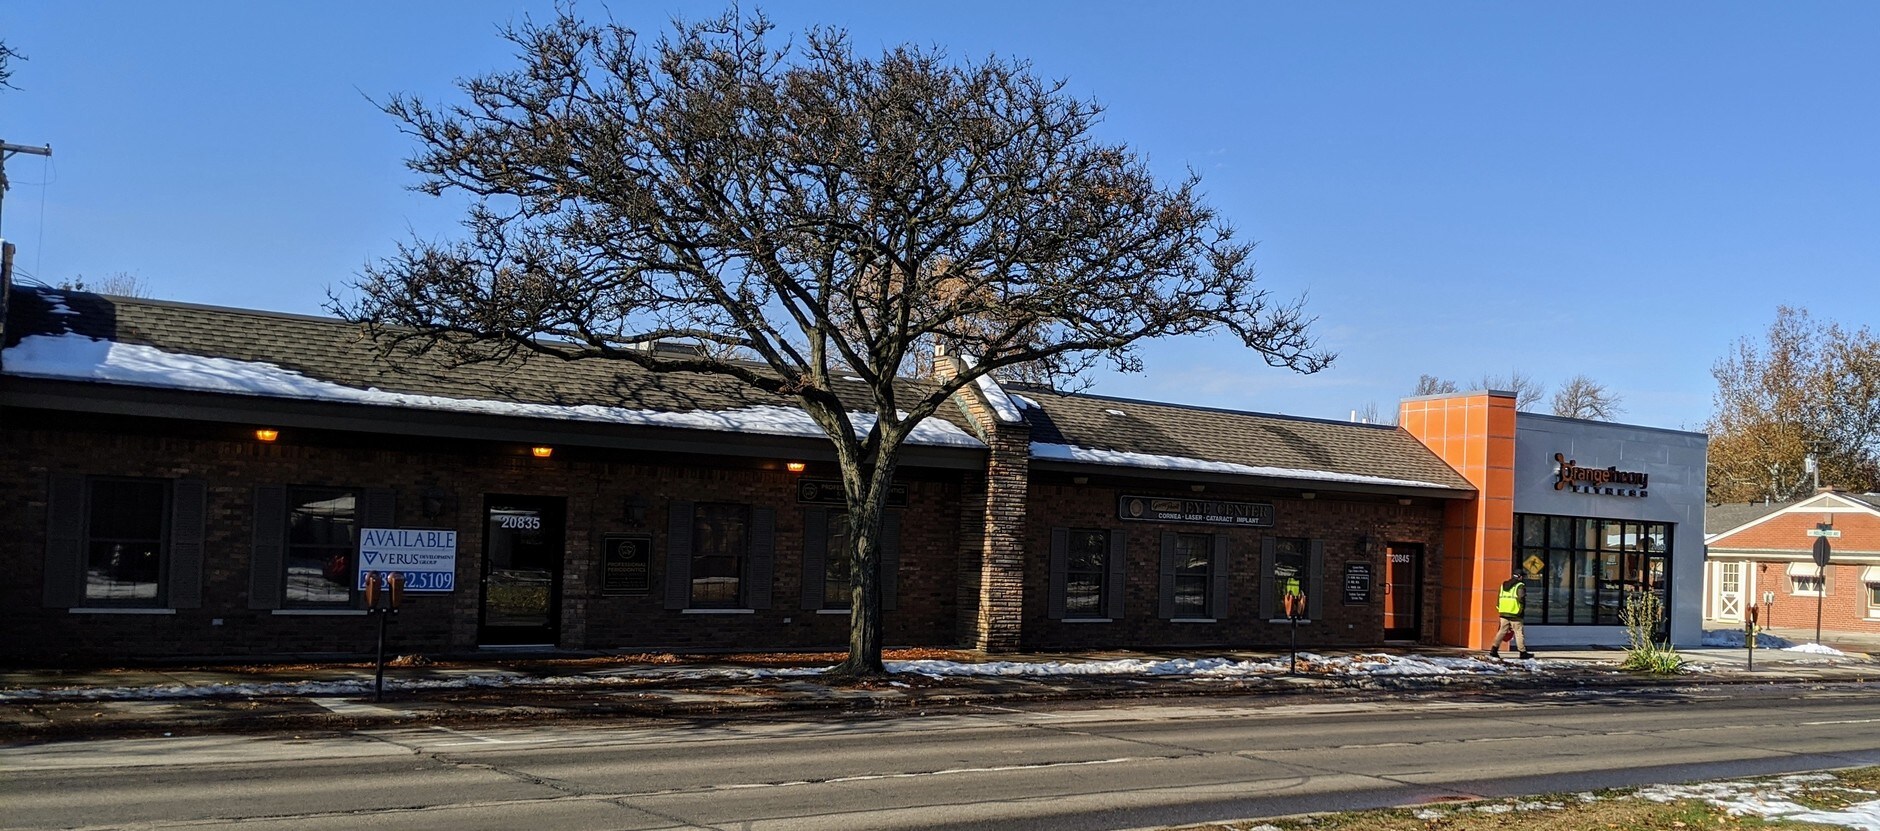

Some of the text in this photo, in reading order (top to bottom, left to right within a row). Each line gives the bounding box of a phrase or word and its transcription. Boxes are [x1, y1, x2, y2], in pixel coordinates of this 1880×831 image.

[1217, 503, 1268, 518] CENTER
[501, 516, 541, 530] 20835
[1158, 512, 1182, 520] CORNEA
[1206, 514, 1233, 523] CATARACT
[363, 530, 454, 548] AVAILABLE
[379, 553, 419, 565] VERUS
[1391, 554, 1410, 563] 20845
